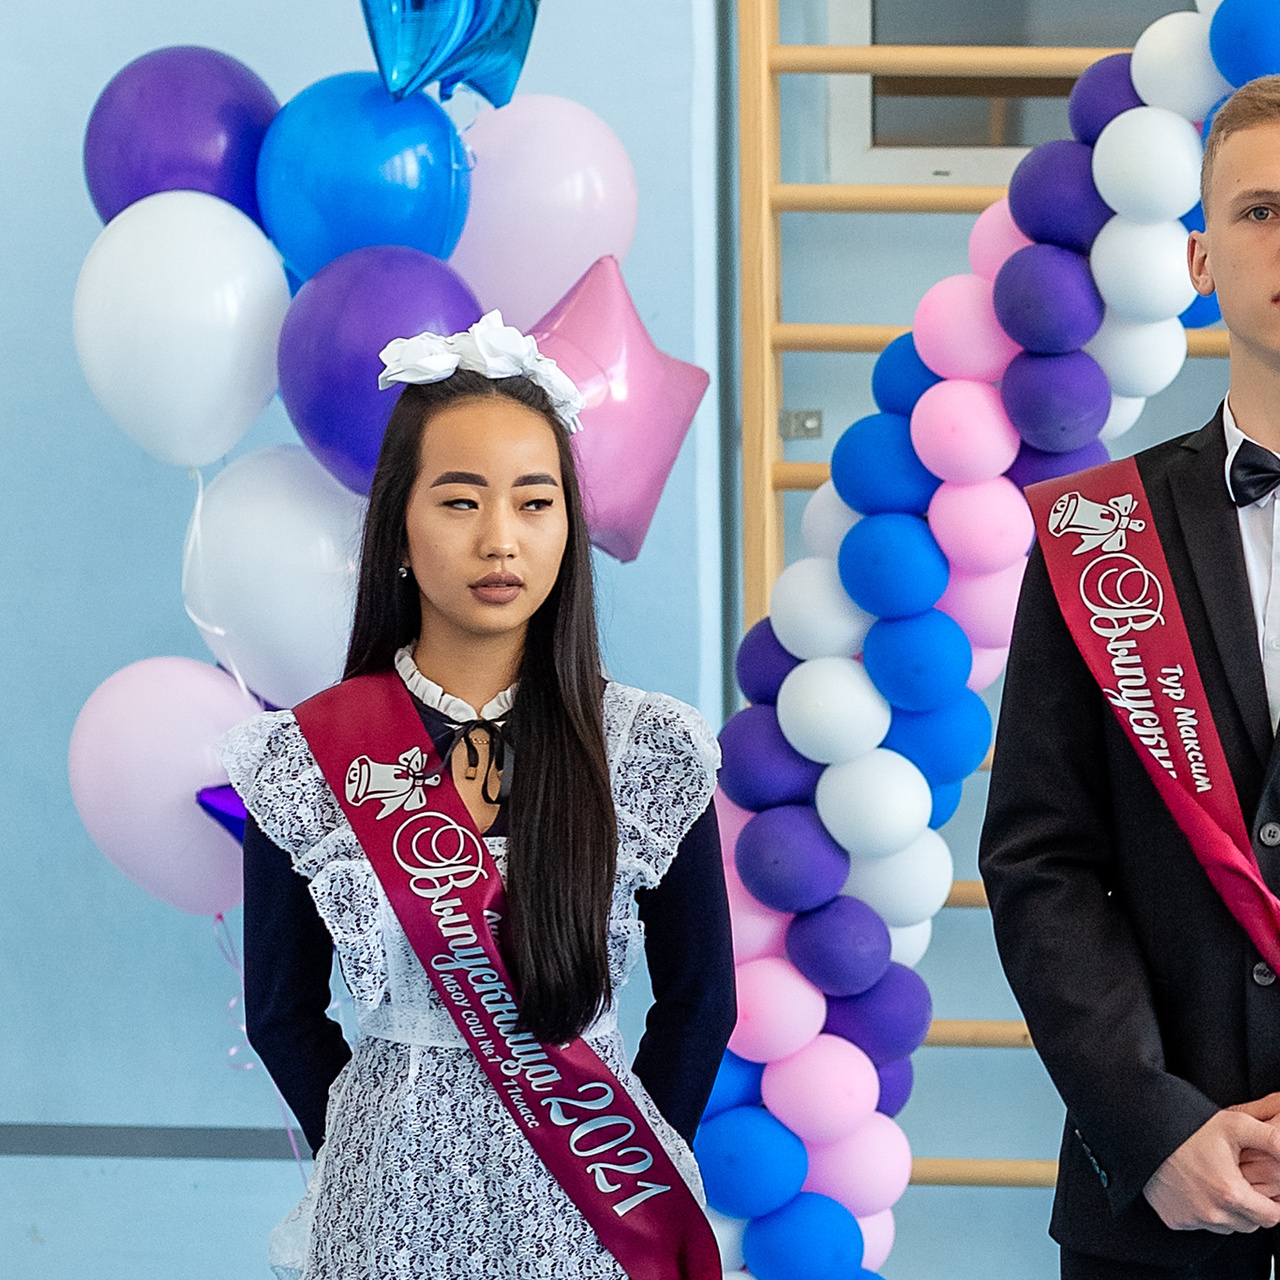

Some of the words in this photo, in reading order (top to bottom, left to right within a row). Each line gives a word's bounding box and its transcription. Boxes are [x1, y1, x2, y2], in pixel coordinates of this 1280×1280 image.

[1157, 664, 1185, 700] Тур
[1173, 707, 1212, 793] Максим
[439, 974, 471, 1007] МБОУ
[461, 1010, 487, 1038] СОШ
[541, 1082, 671, 1217] 2021
